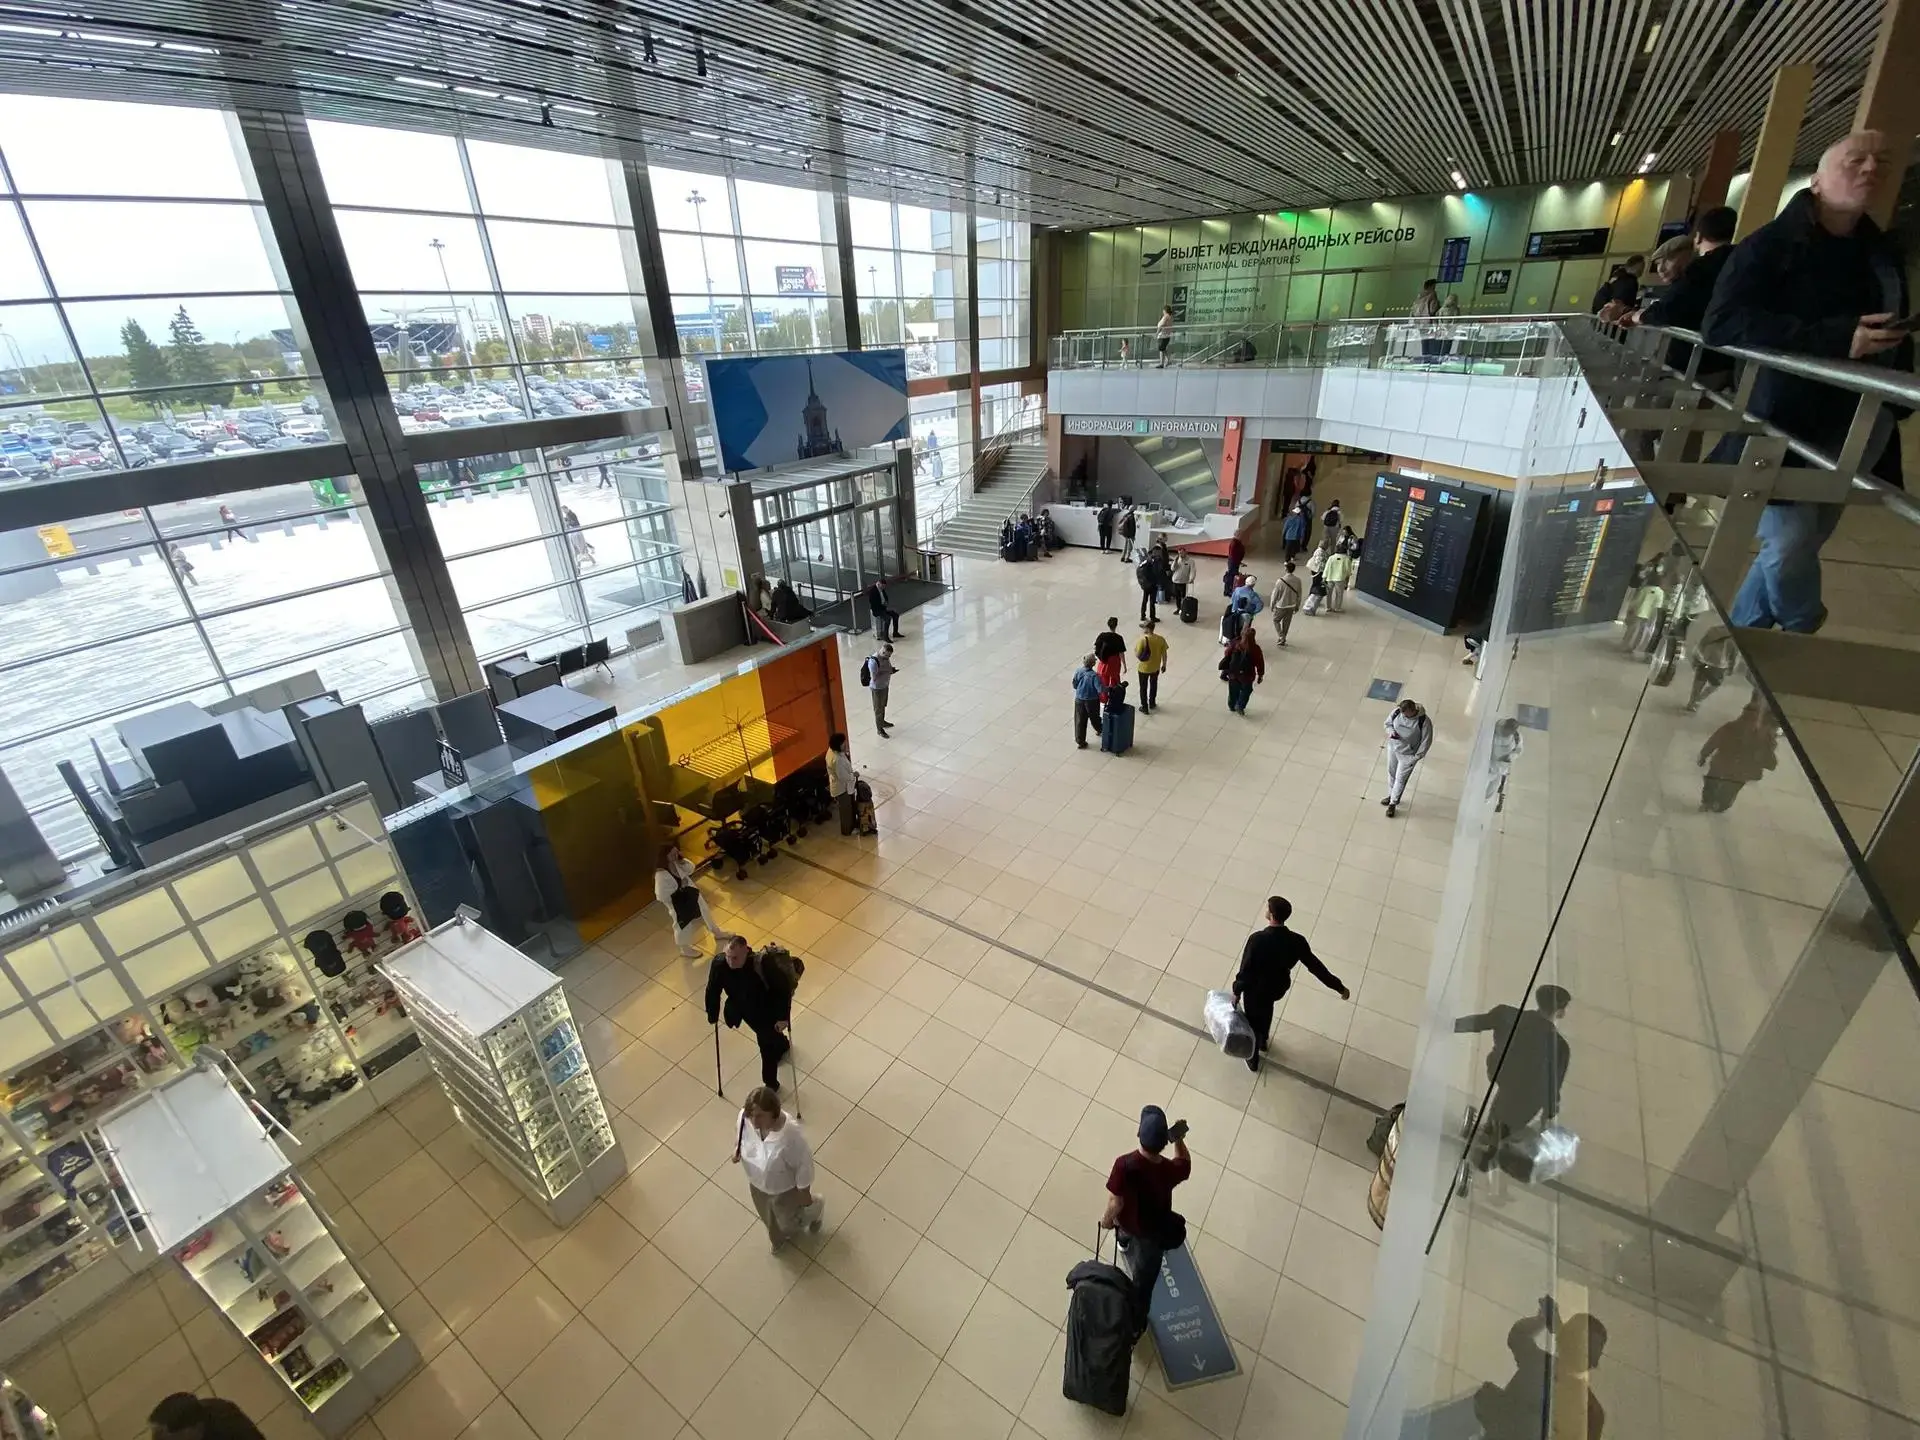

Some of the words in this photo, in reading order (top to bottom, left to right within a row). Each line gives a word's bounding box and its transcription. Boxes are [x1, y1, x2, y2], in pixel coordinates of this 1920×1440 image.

[1170, 244, 1214, 260] ВЫЛЕТ
[1218, 231, 1351, 257] МЕЖДУНАРОДНЫХ
[1354, 227, 1415, 245] РЕЙСОВ
[1174, 260, 1239, 273] INTERNATIONAL
[1241, 255, 1301, 269] DEPARTURES
[1068, 419, 1134, 432] ИНФОРМАЦИЯ
[1150, 420, 1218, 433] INFORMATION
